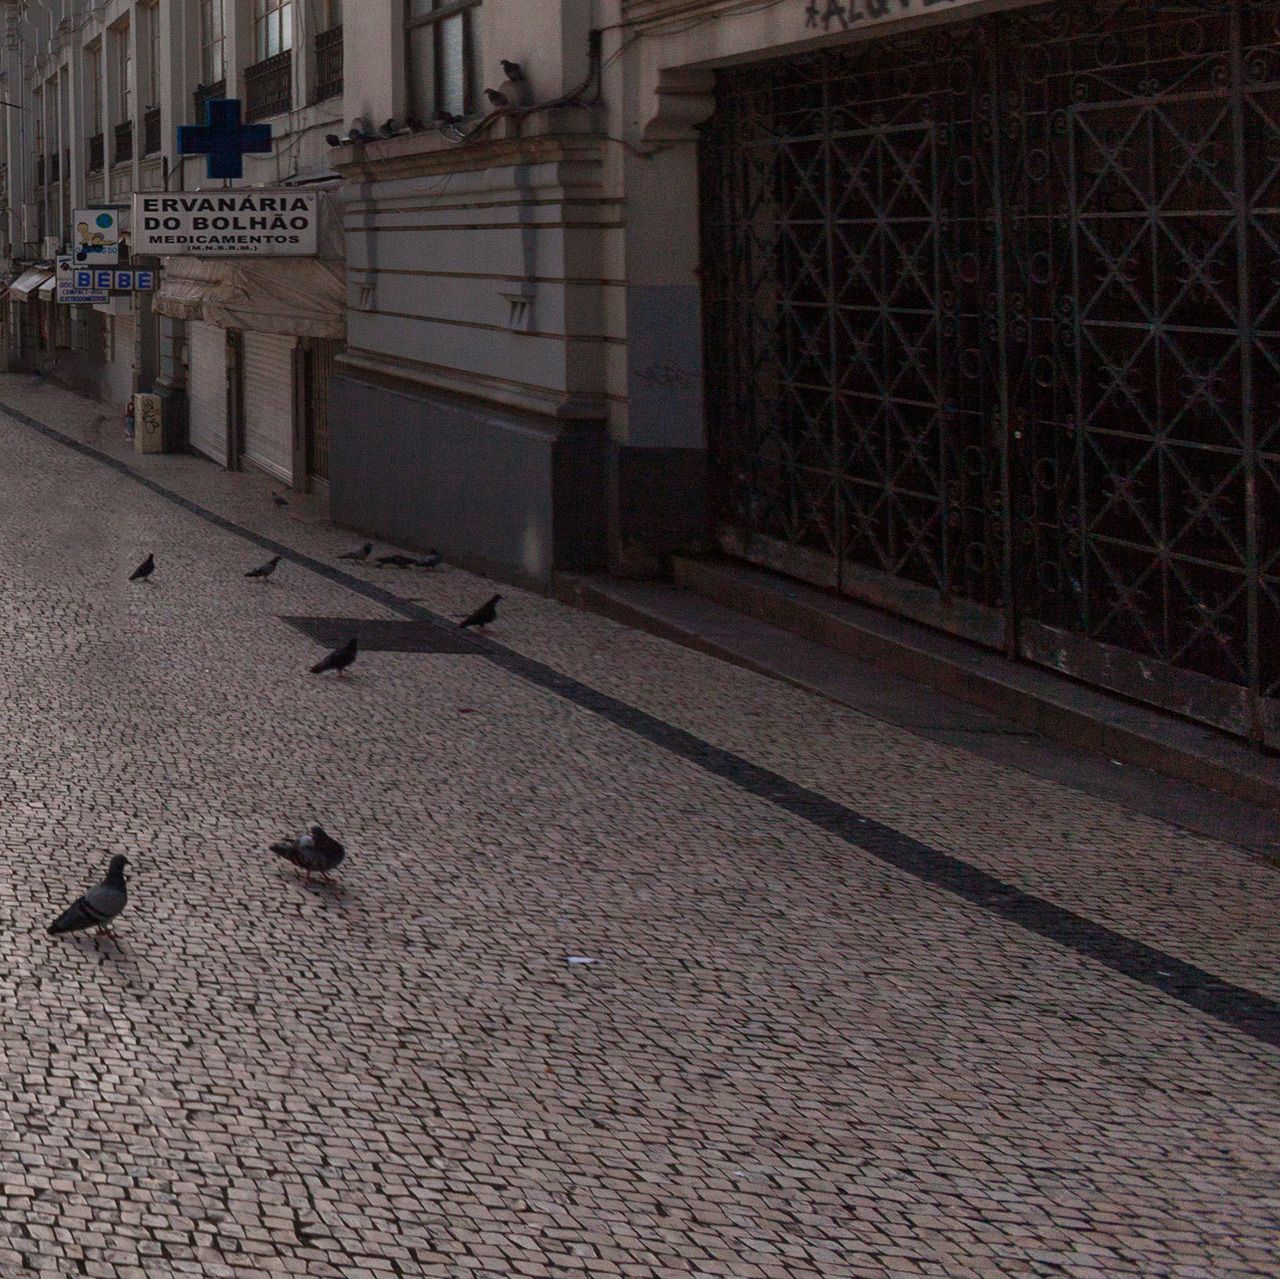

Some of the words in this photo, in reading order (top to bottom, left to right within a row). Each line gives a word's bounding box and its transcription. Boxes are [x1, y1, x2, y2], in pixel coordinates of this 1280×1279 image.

[143, 194, 309, 212] ERVANÁRIA
[143, 217, 181, 231] DO
[192, 213, 309, 231] BOLHÃO
[149, 234, 300, 244] MEDICAMENTOS
